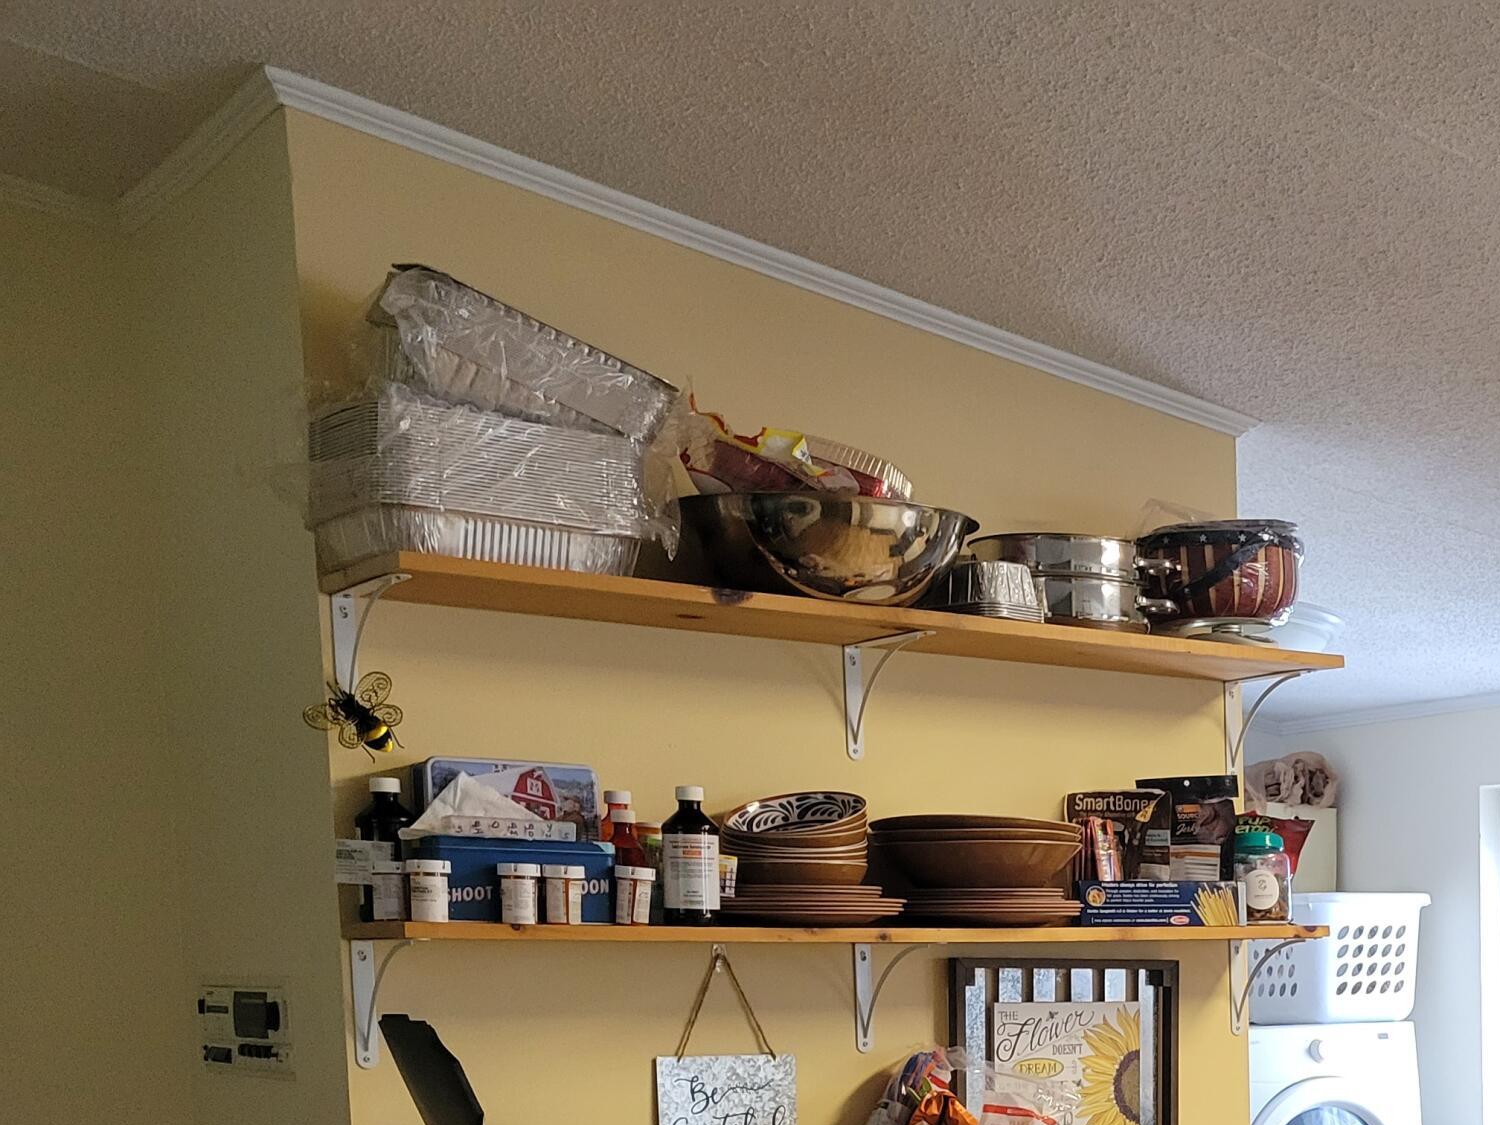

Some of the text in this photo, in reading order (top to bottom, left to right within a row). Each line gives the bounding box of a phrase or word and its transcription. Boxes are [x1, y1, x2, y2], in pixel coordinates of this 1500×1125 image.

[581, 878, 610, 895] OON
[998, 1010, 1019, 1022] THE
[995, 1010, 1095, 1063] Flower
[1019, 1062, 1057, 1075] DREAM
